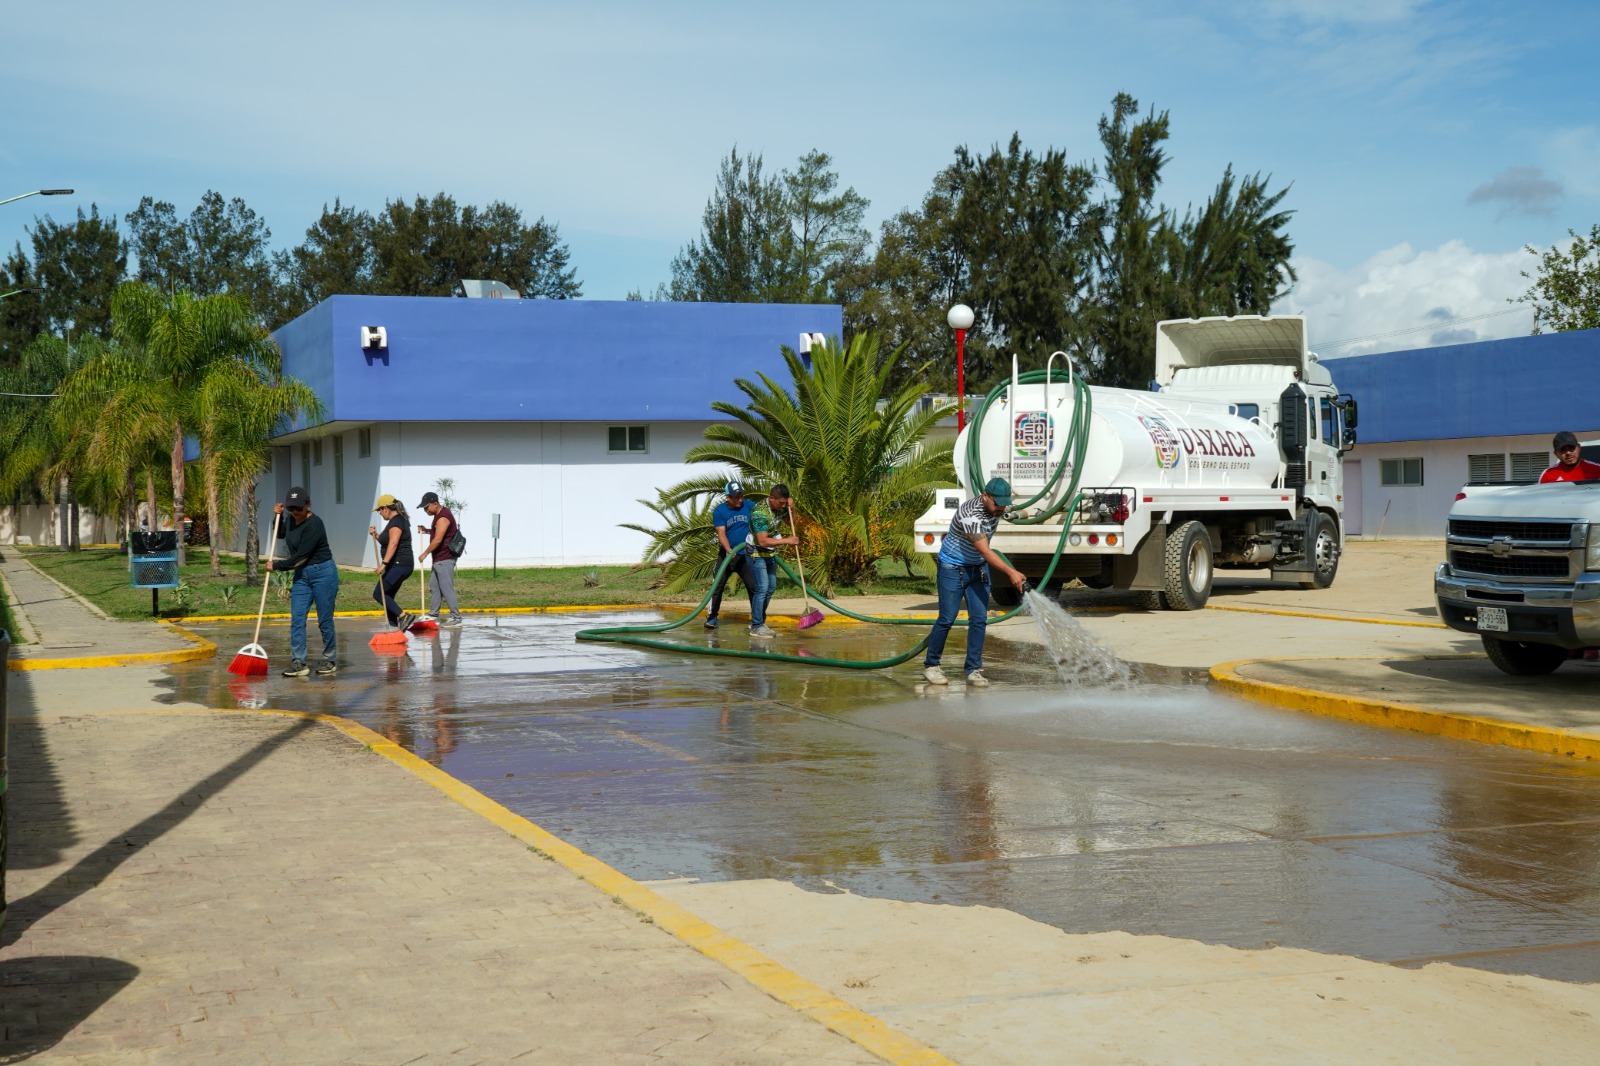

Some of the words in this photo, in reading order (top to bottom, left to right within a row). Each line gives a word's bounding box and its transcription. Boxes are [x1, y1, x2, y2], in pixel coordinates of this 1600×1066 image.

[1178, 428, 1255, 457] OAXACA
[1189, 460, 1217, 469] GOBERNO
[1219, 461, 1228, 469] DEL
